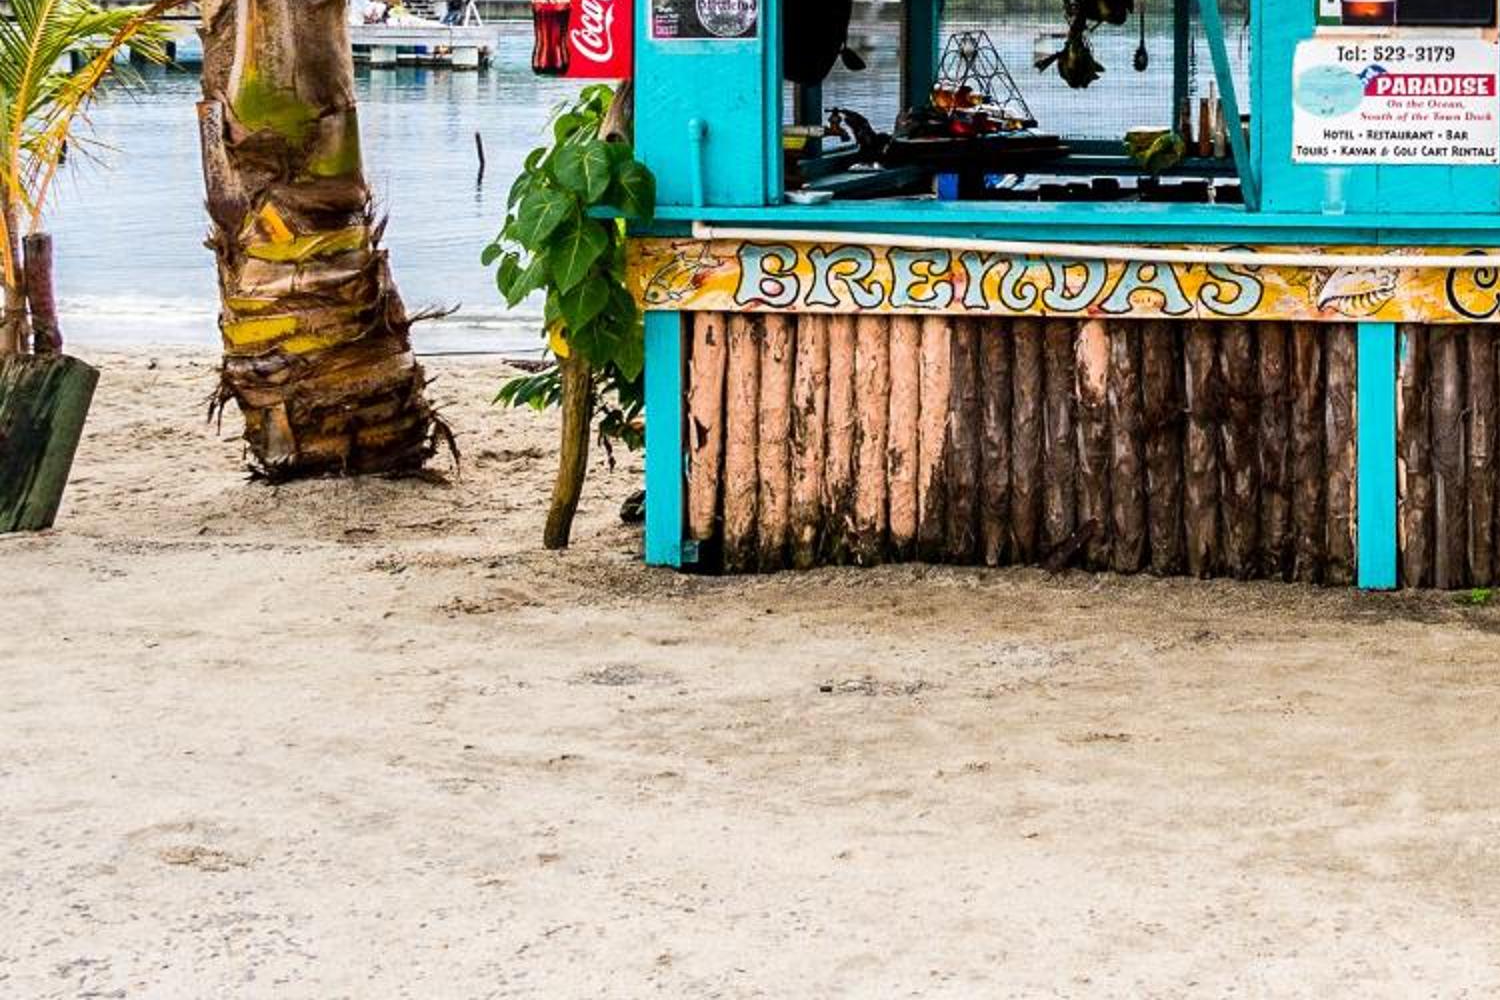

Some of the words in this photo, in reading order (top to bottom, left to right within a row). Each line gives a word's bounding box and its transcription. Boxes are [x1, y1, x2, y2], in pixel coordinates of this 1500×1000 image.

[1373, 46, 1456, 62] 523-3179
[1376, 76, 1490, 95] PARADISE
[1387, 99, 1403, 109] On
[1406, 99, 1424, 109] the
[1360, 112, 1393, 121] South
[1397, 111, 1409, 122] of
[1413, 111, 1428, 121] the
[1433, 112, 1461, 121] Town
[1464, 112, 1493, 121] Dock
[1323, 130, 1355, 140] HOTEL
[1366, 130, 1433, 140] RESTAURANT
[1446, 129, 1469, 140] BAR
[1296, 145, 1328, 156] TOURS
[1340, 146, 1376, 156] KAYAK
[1421, 145, 1447, 156] CART
[1451, 146, 1496, 156] RENTALS
